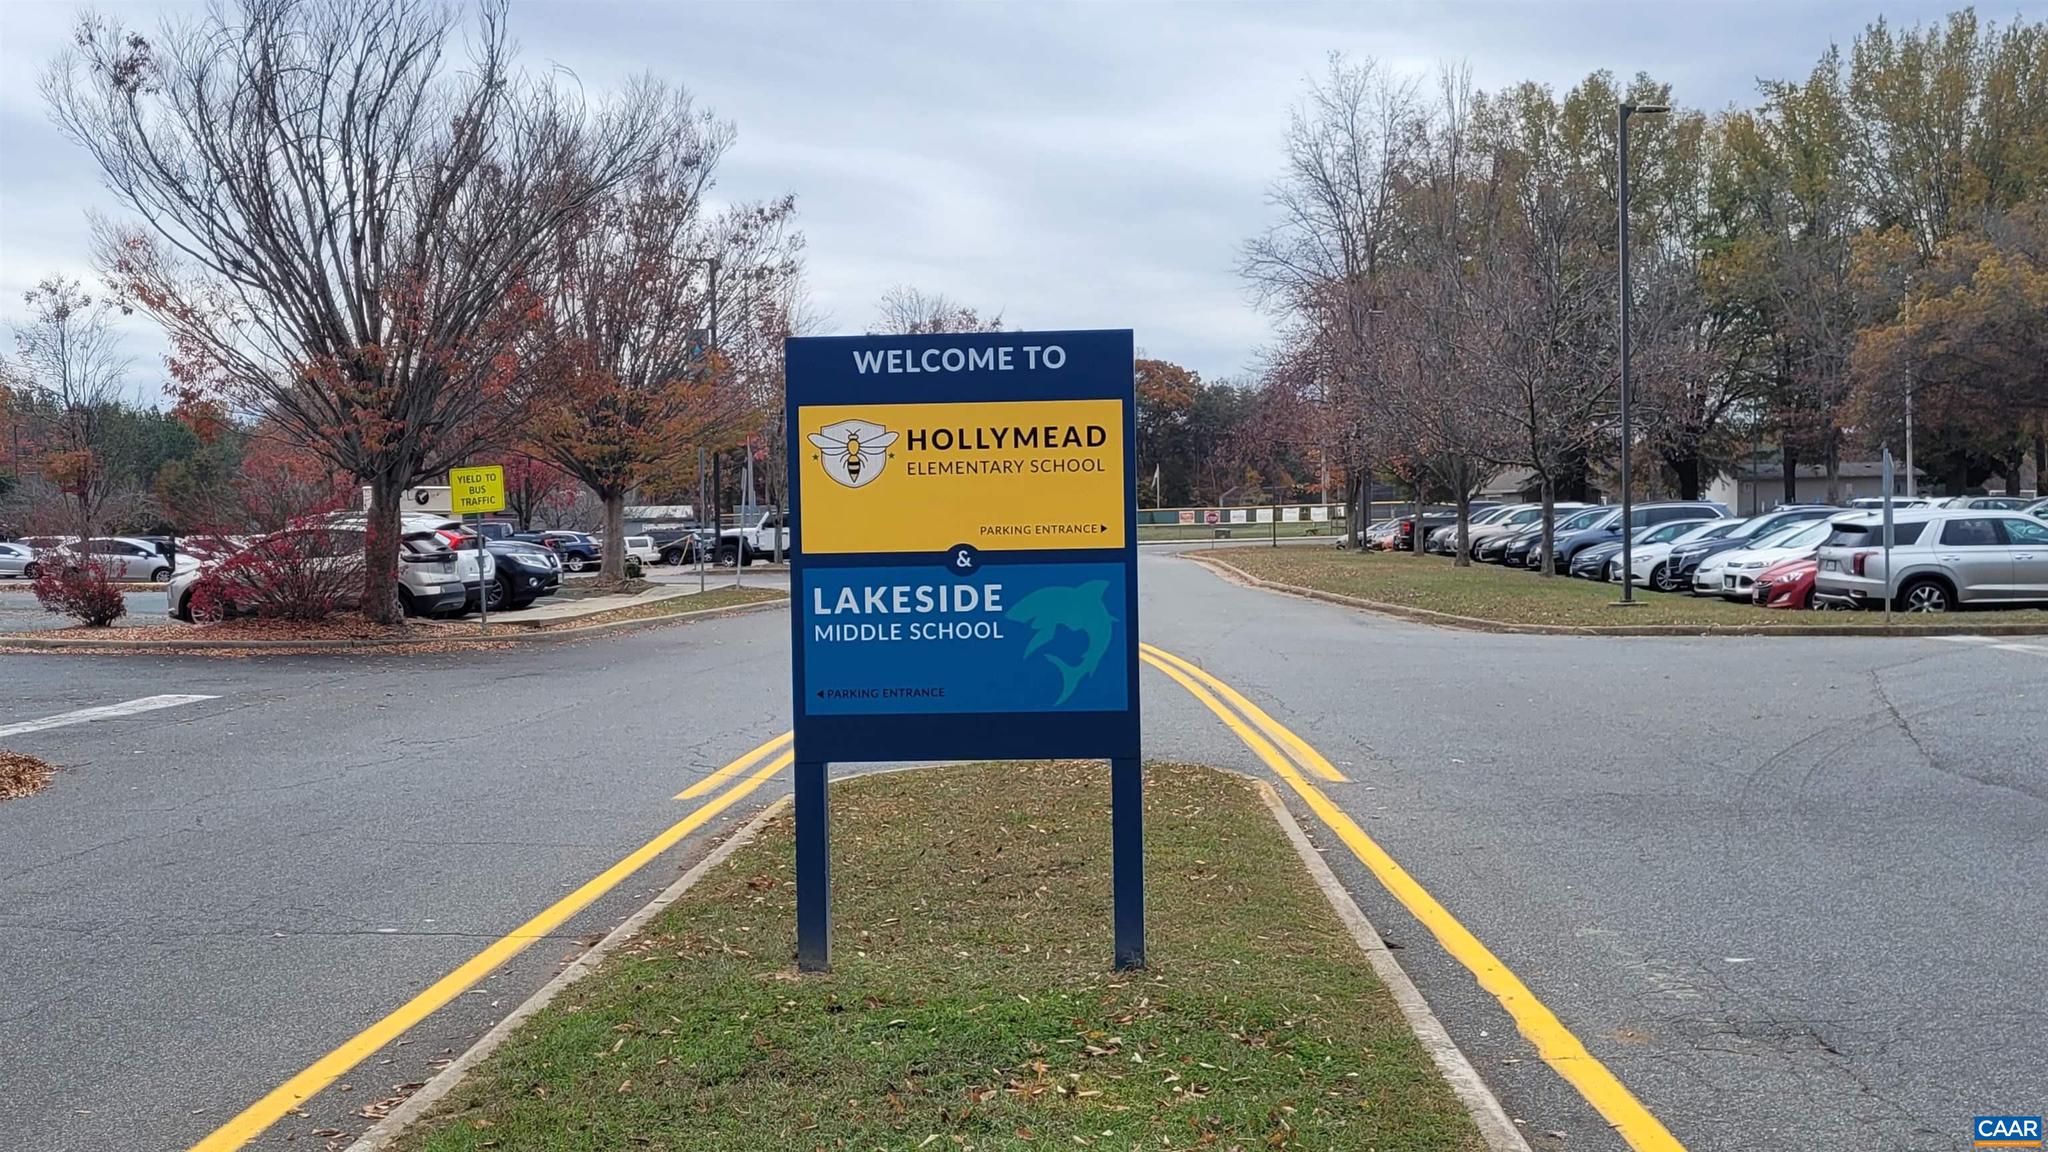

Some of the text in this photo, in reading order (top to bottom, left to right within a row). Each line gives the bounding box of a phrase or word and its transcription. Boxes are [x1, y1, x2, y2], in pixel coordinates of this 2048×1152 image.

[853, 345, 1067, 374] WELCOME TO
[906, 425, 1107, 451] HOLLYMEAD
[907, 458, 1105, 475] ELEMENTARY SCHOOL
[457, 473, 497, 484] YIELD TO
[469, 486, 486, 495] BUS
[460, 496, 496, 506] TRAFFIC
[980, 523, 1098, 536] PARKING ENTRANCE
[956, 550, 972, 568] &
[813, 584, 1003, 615] LAKESIDE
[815, 621, 1004, 642] MIDDLE SCHOOL
[827, 688, 945, 699] PARKING ENTRANCE
